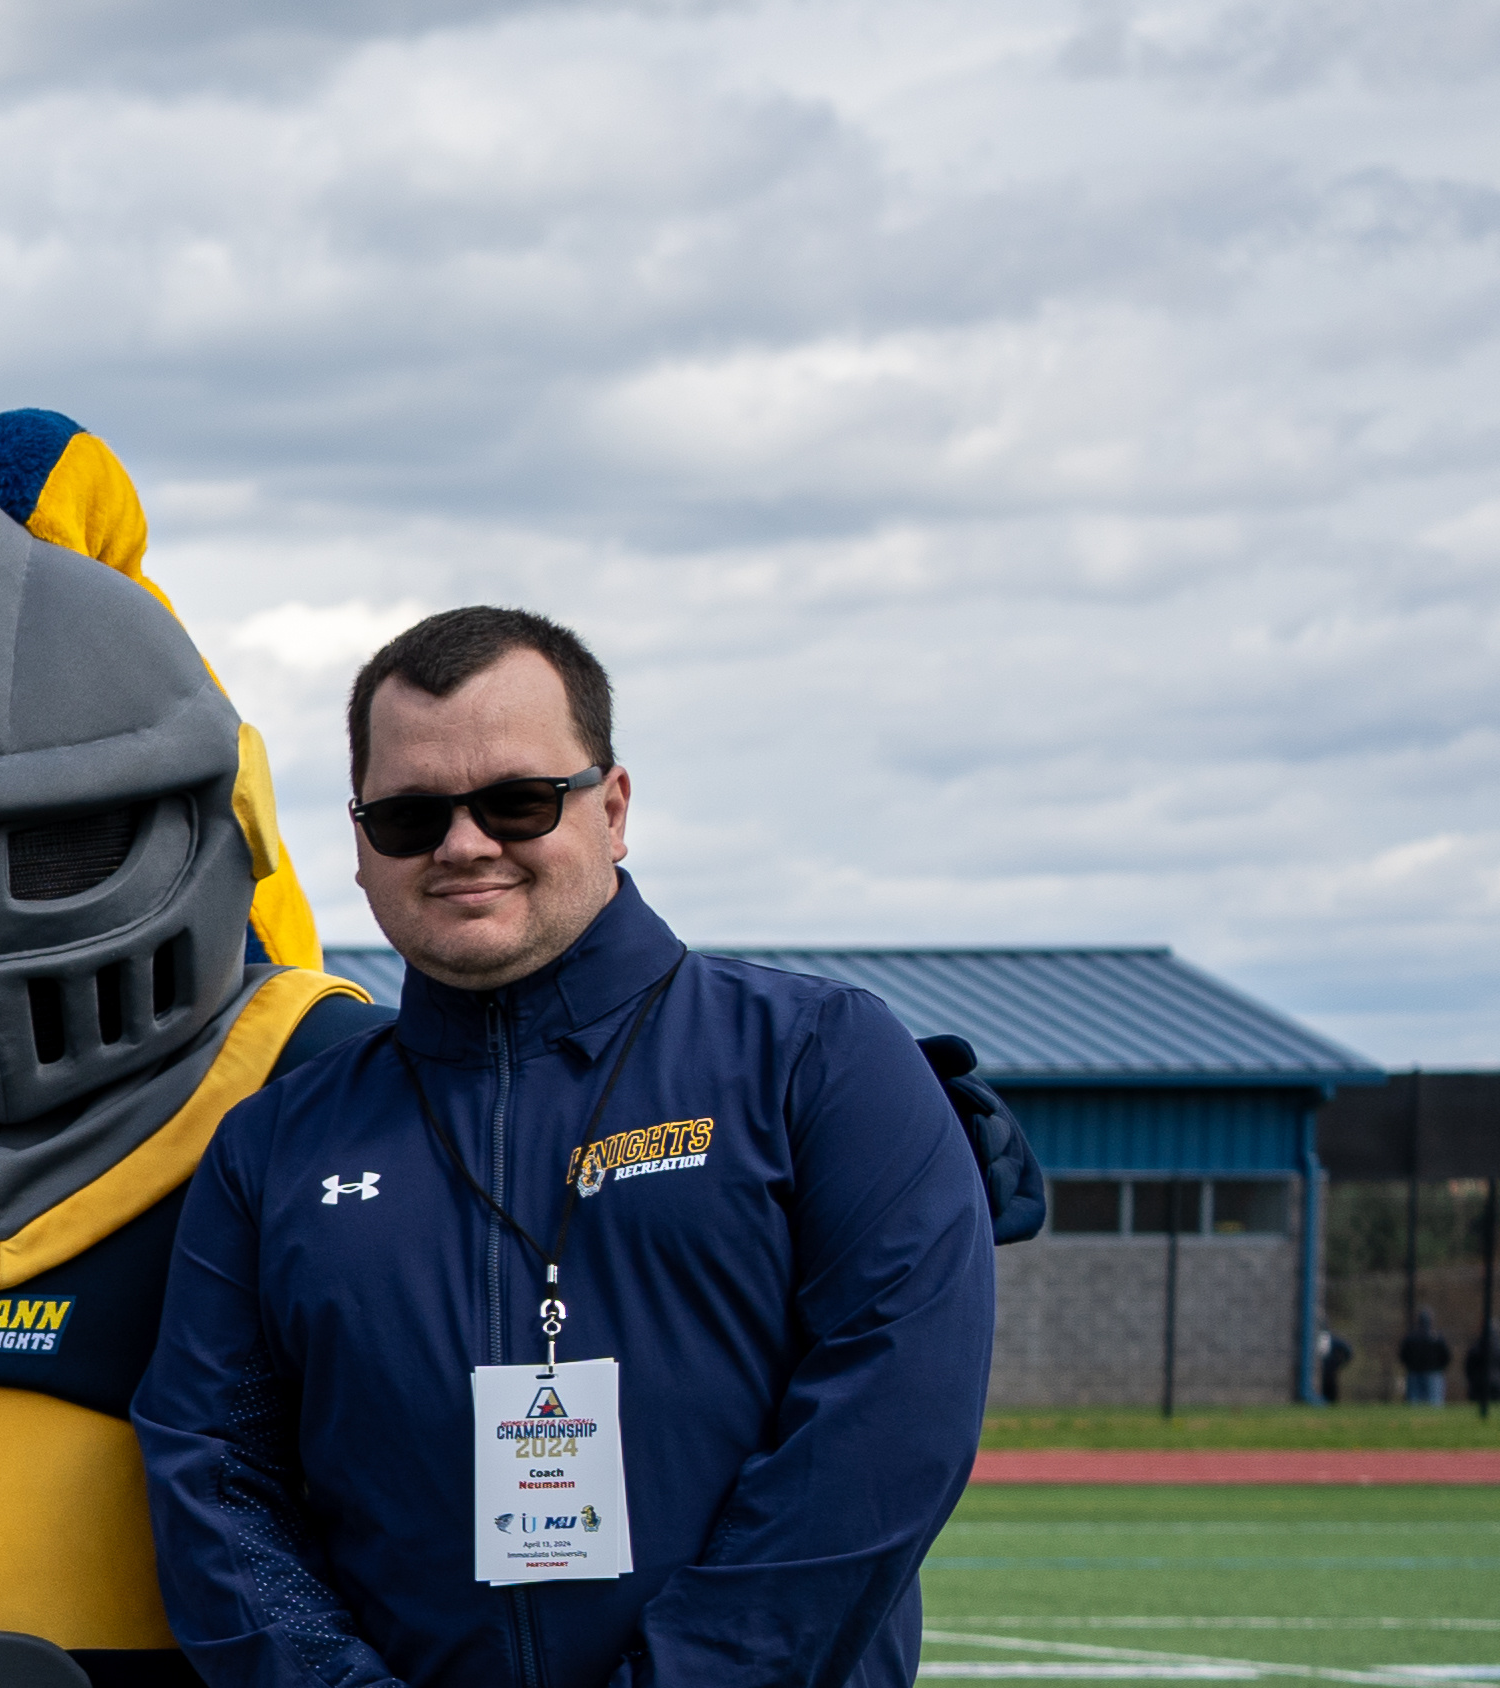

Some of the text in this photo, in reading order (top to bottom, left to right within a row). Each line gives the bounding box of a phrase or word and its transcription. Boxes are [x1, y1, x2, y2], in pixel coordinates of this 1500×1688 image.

[614, 1153, 708, 1182] RECREATION
[497, 1423, 597, 1439] CHAMPIONSHIP
[516, 1437, 579, 1458] 2024
[529, 1468, 565, 1478] Coach
[519, 1481, 575, 1489] Neumann
